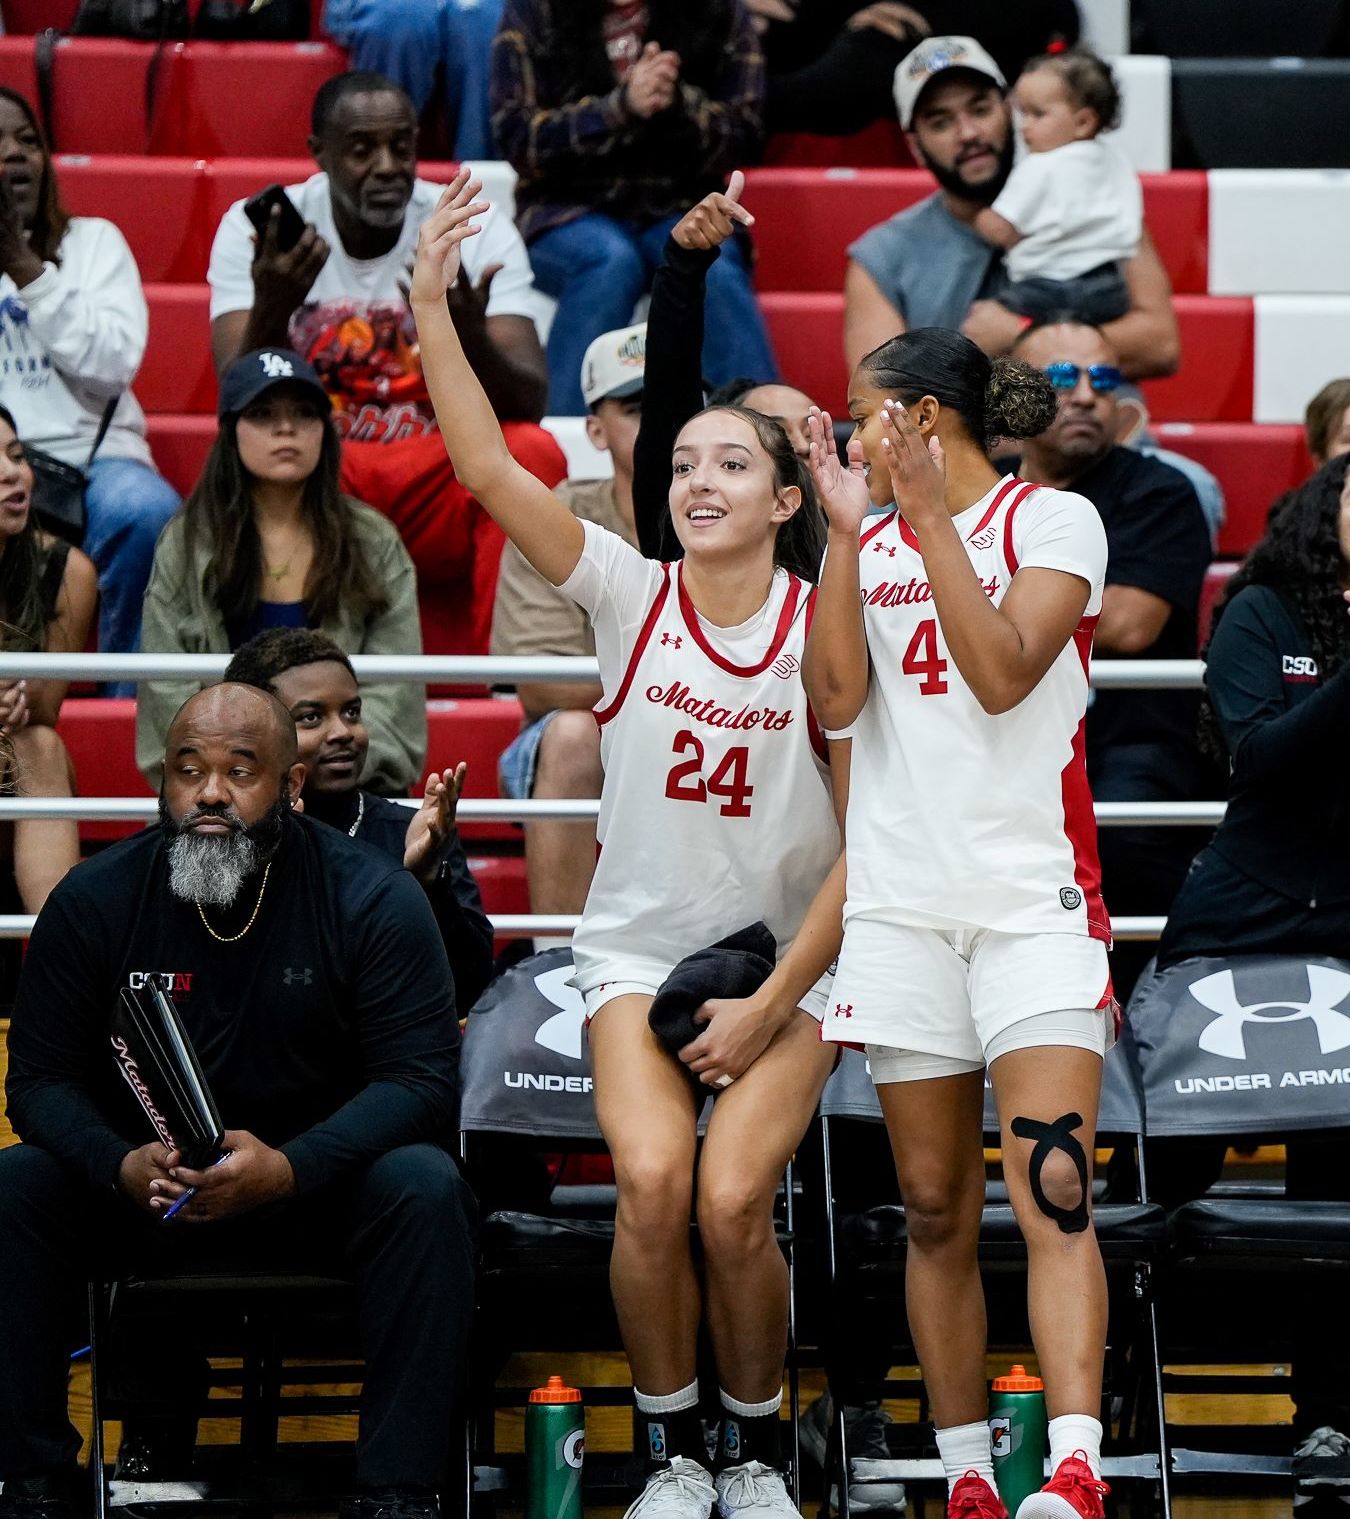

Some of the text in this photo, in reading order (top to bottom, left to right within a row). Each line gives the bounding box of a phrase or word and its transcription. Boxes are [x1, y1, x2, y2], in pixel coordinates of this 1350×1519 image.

[259, 352, 294, 377] LA
[902, 619, 948, 696] 4
[646, 681, 794, 731] Matadors
[665, 730, 754, 818] 24
[110, 1035, 176, 1152] Matador
[1175, 1073, 1271, 1094] UNDER
